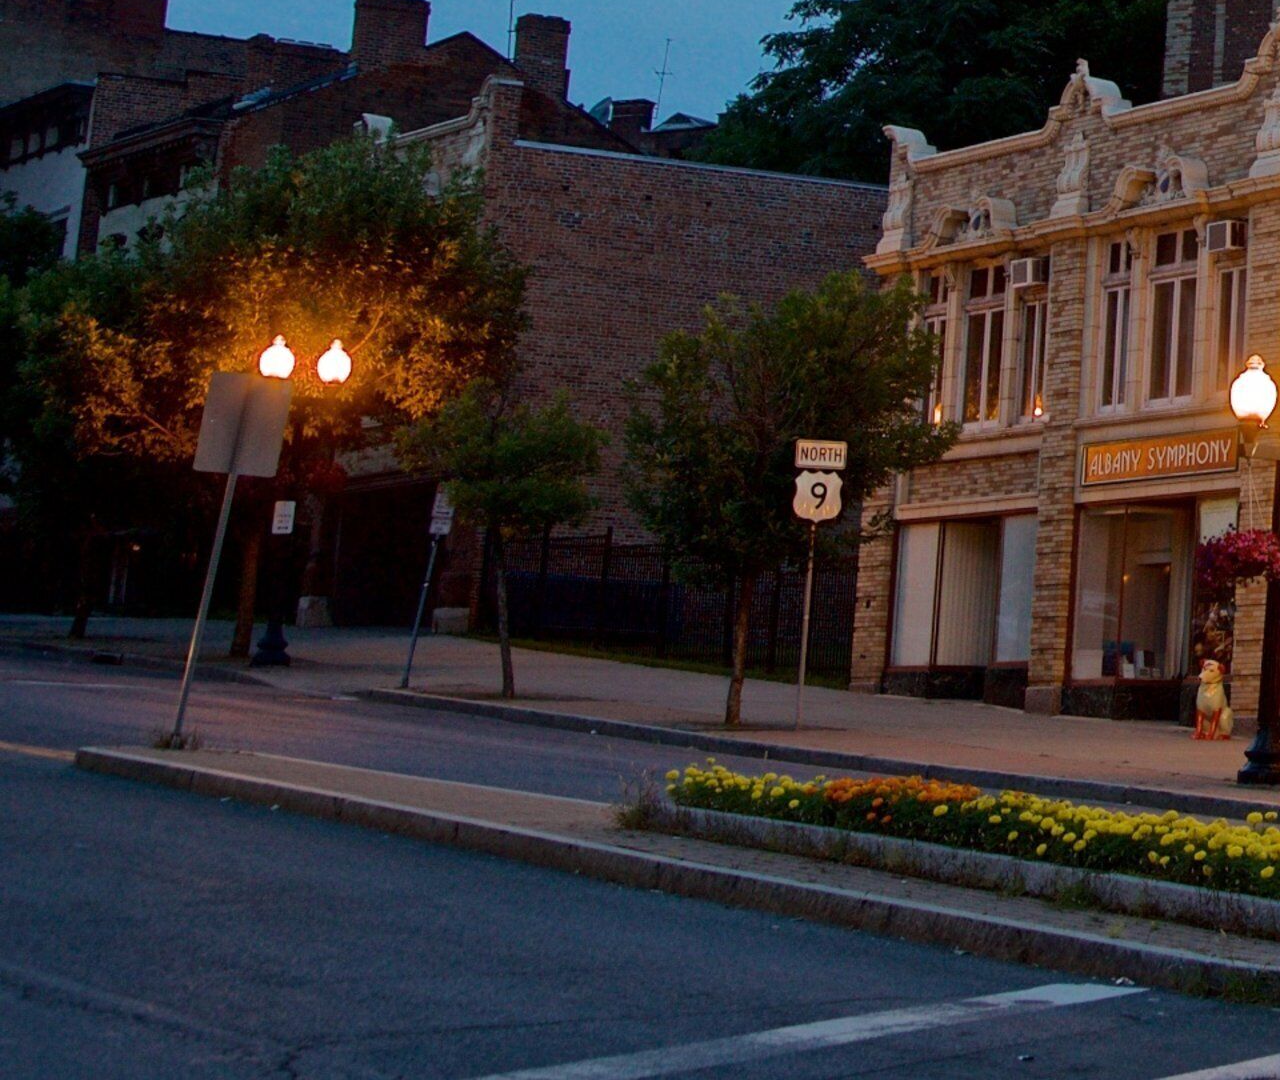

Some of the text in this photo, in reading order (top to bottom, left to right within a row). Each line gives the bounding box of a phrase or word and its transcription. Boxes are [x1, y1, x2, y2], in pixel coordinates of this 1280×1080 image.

[800, 446, 843, 462] NORTH
[1088, 439, 1232, 476] ALBANY SYMPHONY
[811, 482, 827, 509] 9
